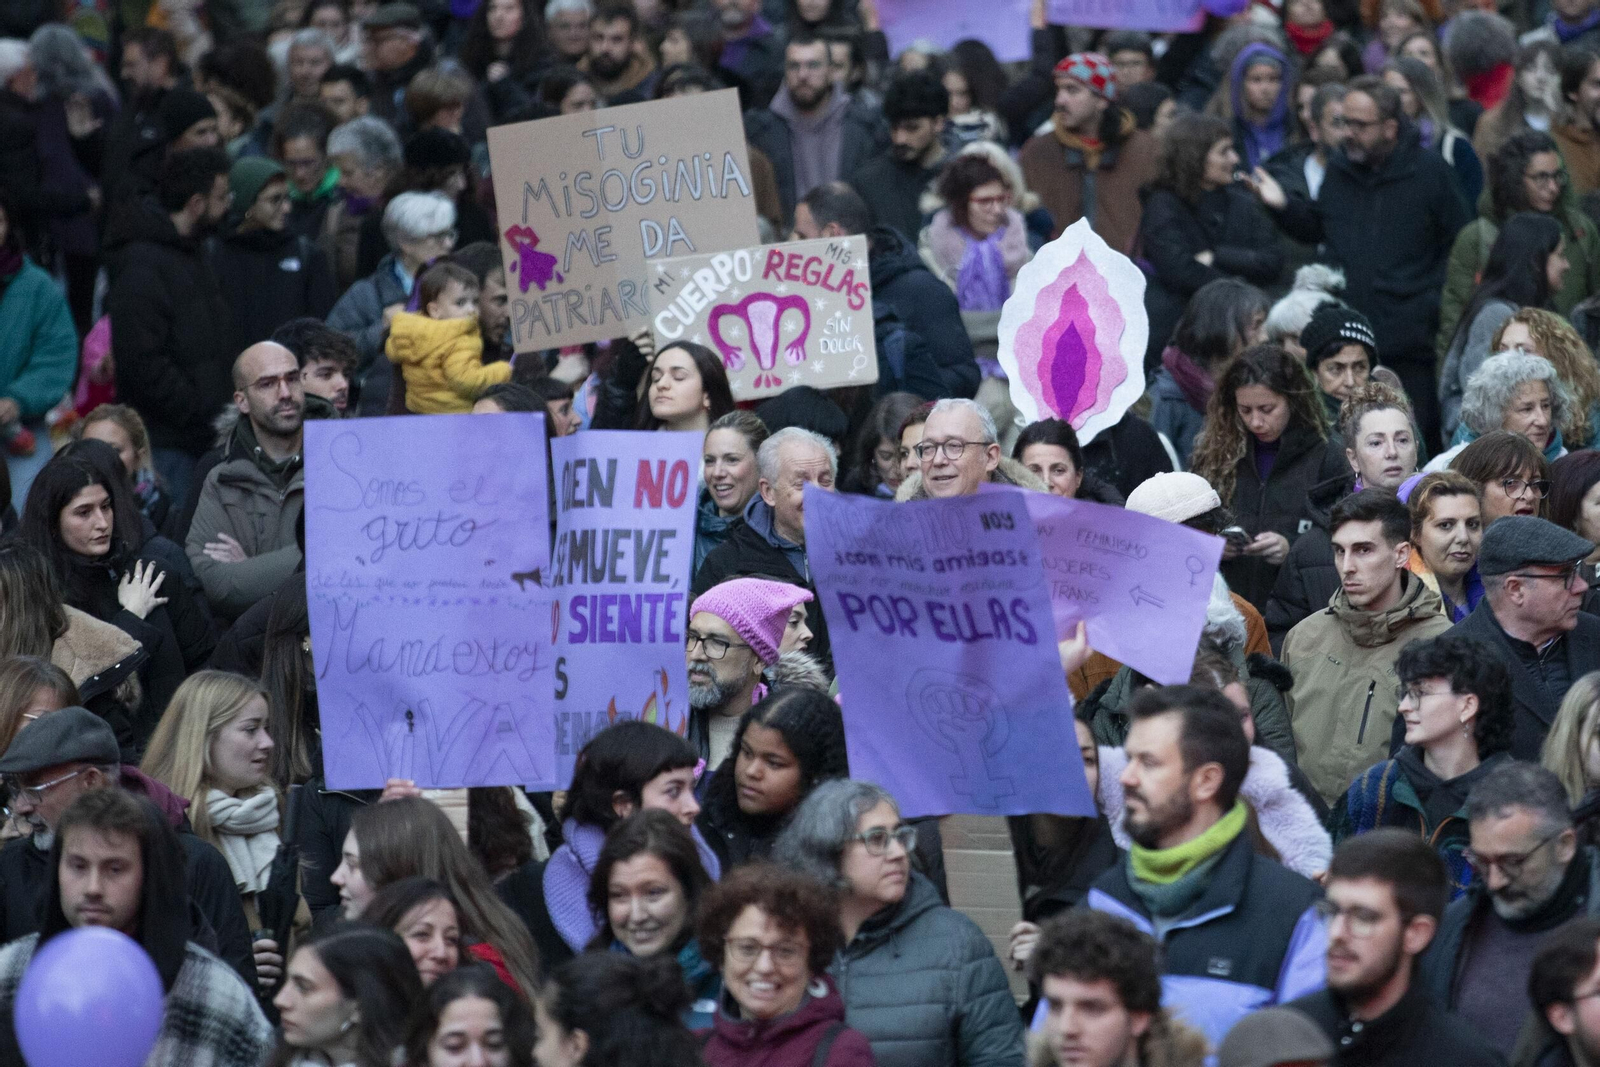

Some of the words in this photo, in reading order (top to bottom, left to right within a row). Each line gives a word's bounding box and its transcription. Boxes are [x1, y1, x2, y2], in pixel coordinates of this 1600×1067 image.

[582, 125, 644, 161] TU
[562, 225, 617, 273] ME
[639, 215, 697, 258] DA
[824, 243, 852, 265] MIS
[653, 271, 676, 295] MI
[654, 249, 752, 340] CUERPO
[762, 248, 869, 311] REGLAS
[822, 316, 853, 335] SIN
[312, 430, 426, 513] Somos
[448, 475, 499, 506] el
[633, 459, 690, 510] NO
[360, 509, 500, 564] grito
[886, 552, 925, 573] mis
[932, 549, 1017, 574] amigas
[567, 592, 684, 645] SIENTE
[837, 592, 919, 639] POR
[925, 597, 1038, 645] ELLAS
[1051, 580, 1099, 605] TRANS
